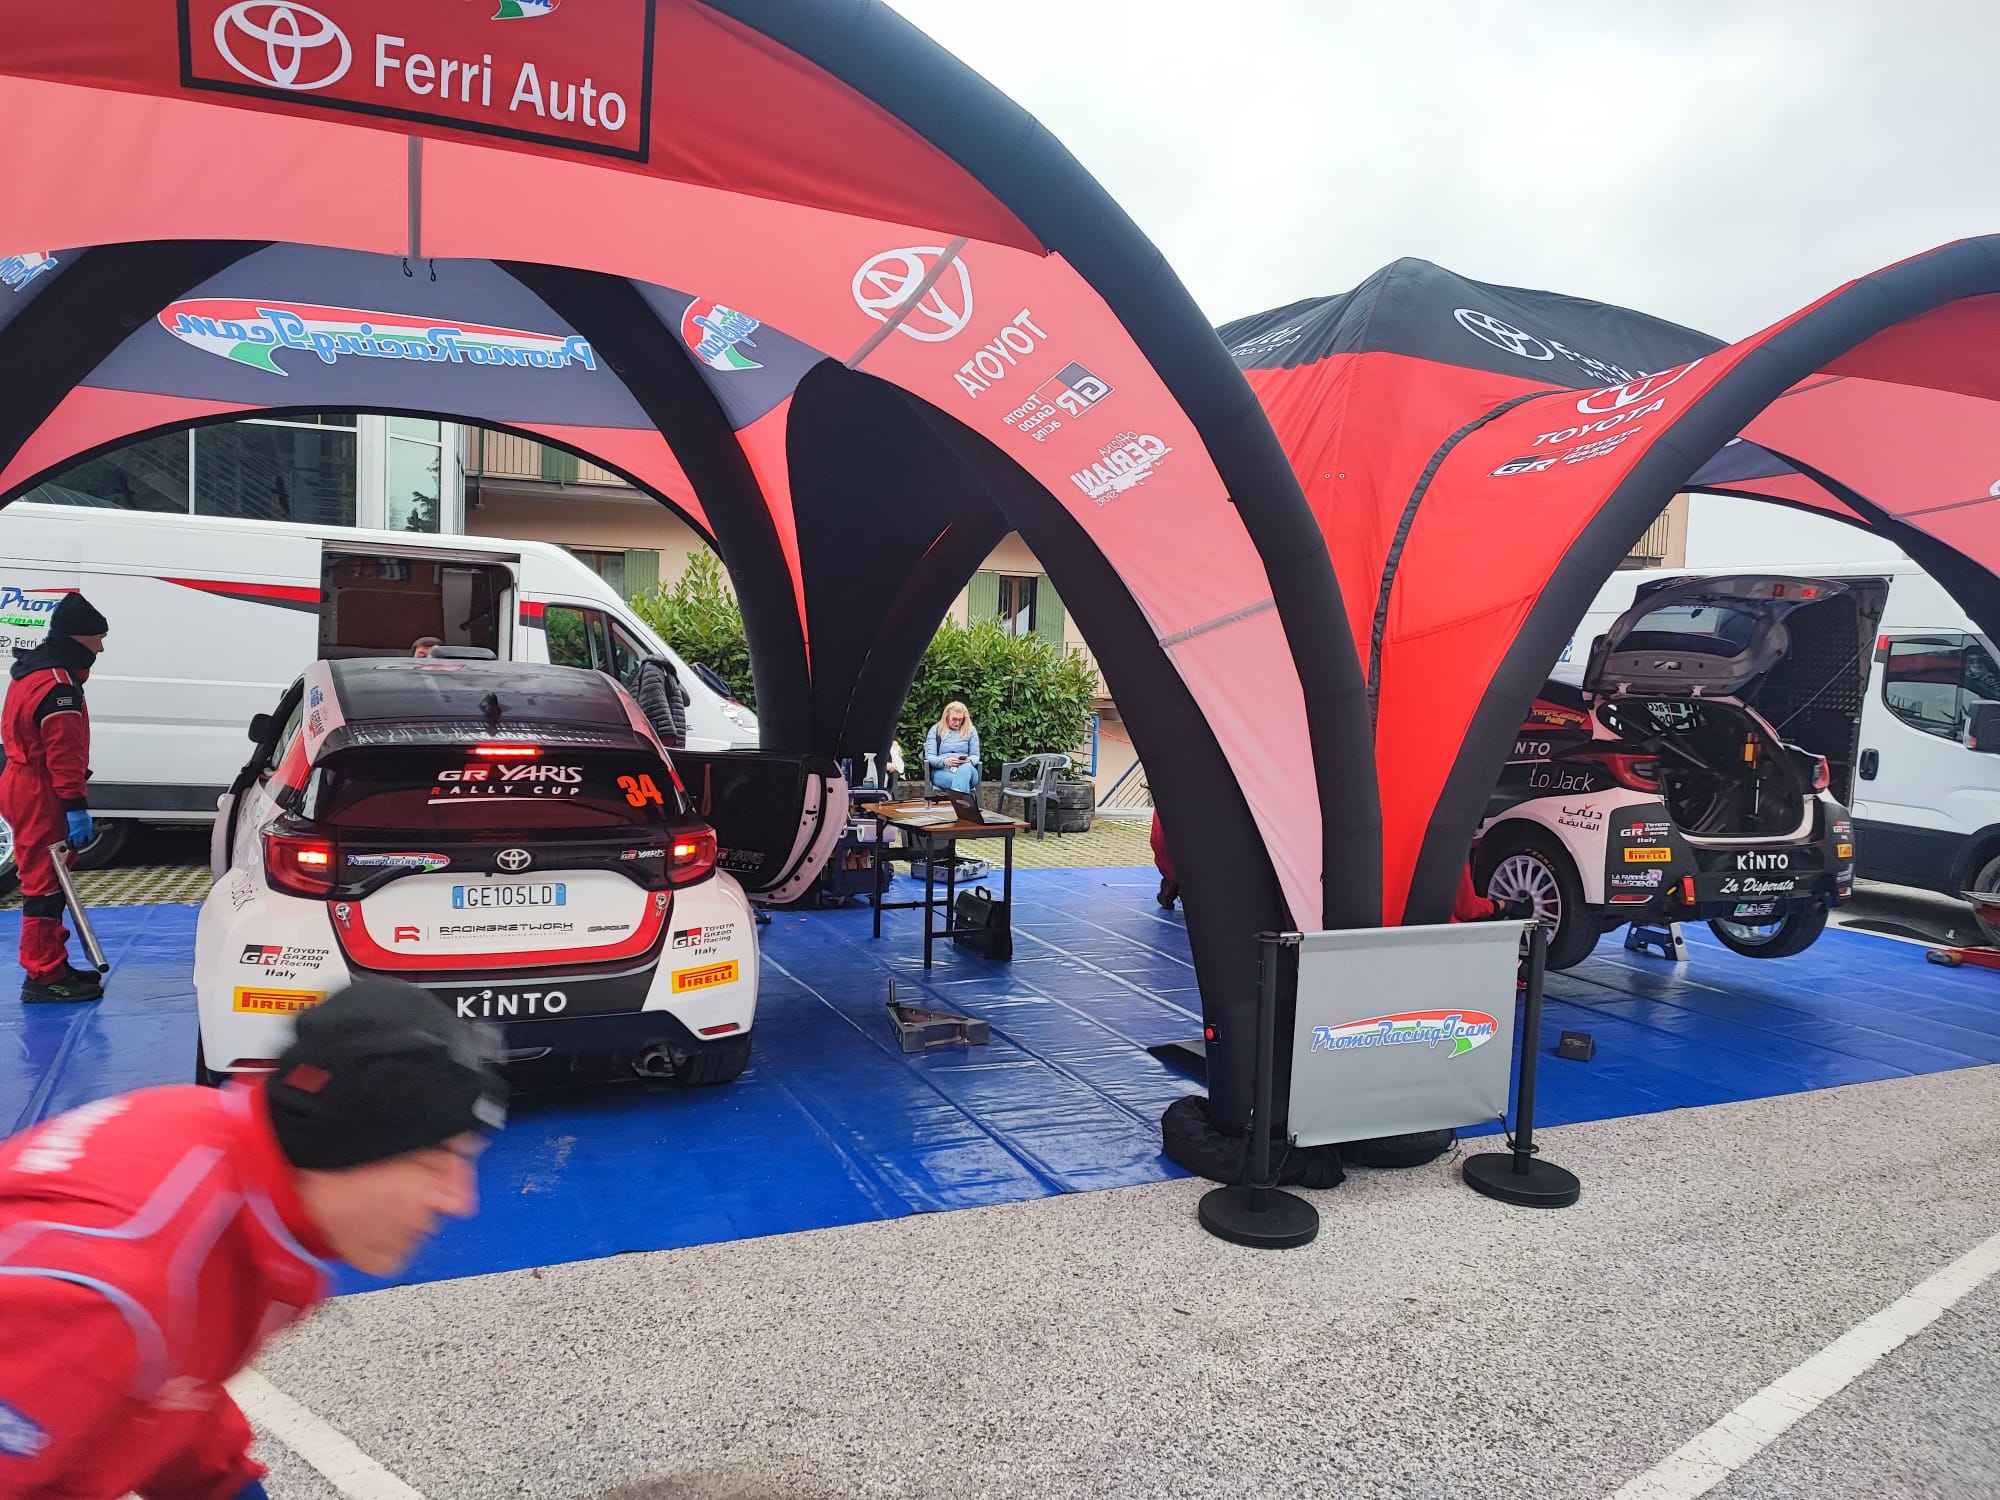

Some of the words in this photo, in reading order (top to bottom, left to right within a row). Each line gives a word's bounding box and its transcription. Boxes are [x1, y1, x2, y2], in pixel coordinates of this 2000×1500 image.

[375, 33, 492, 107] Ferri
[509, 62, 626, 131] Auto
[1531, 397, 1666, 446] TOYOTA
[1491, 458, 1557, 476] GR
[14, 637, 37, 648] Ferri
[437, 765, 489, 781] GR
[431, 785, 514, 795] RALLY
[532, 786, 579, 795] CUP
[617, 774, 664, 808] 34
[1620, 828, 1644, 837] GR
[1628, 850, 1667, 860] PIRELLI
[467, 885, 553, 906] GE105LD
[704, 923, 735, 932] TOYOTA
[673, 934, 700, 949] GR
[286, 946, 330, 955] TOYOTA
[694, 947, 717, 956] Italy
[240, 951, 278, 966] GR
[282, 953, 324, 961] GAZOO
[279, 959, 320, 969] Racing
[265, 969, 297, 980] Italy
[678, 965, 732, 989] PIRELLI
